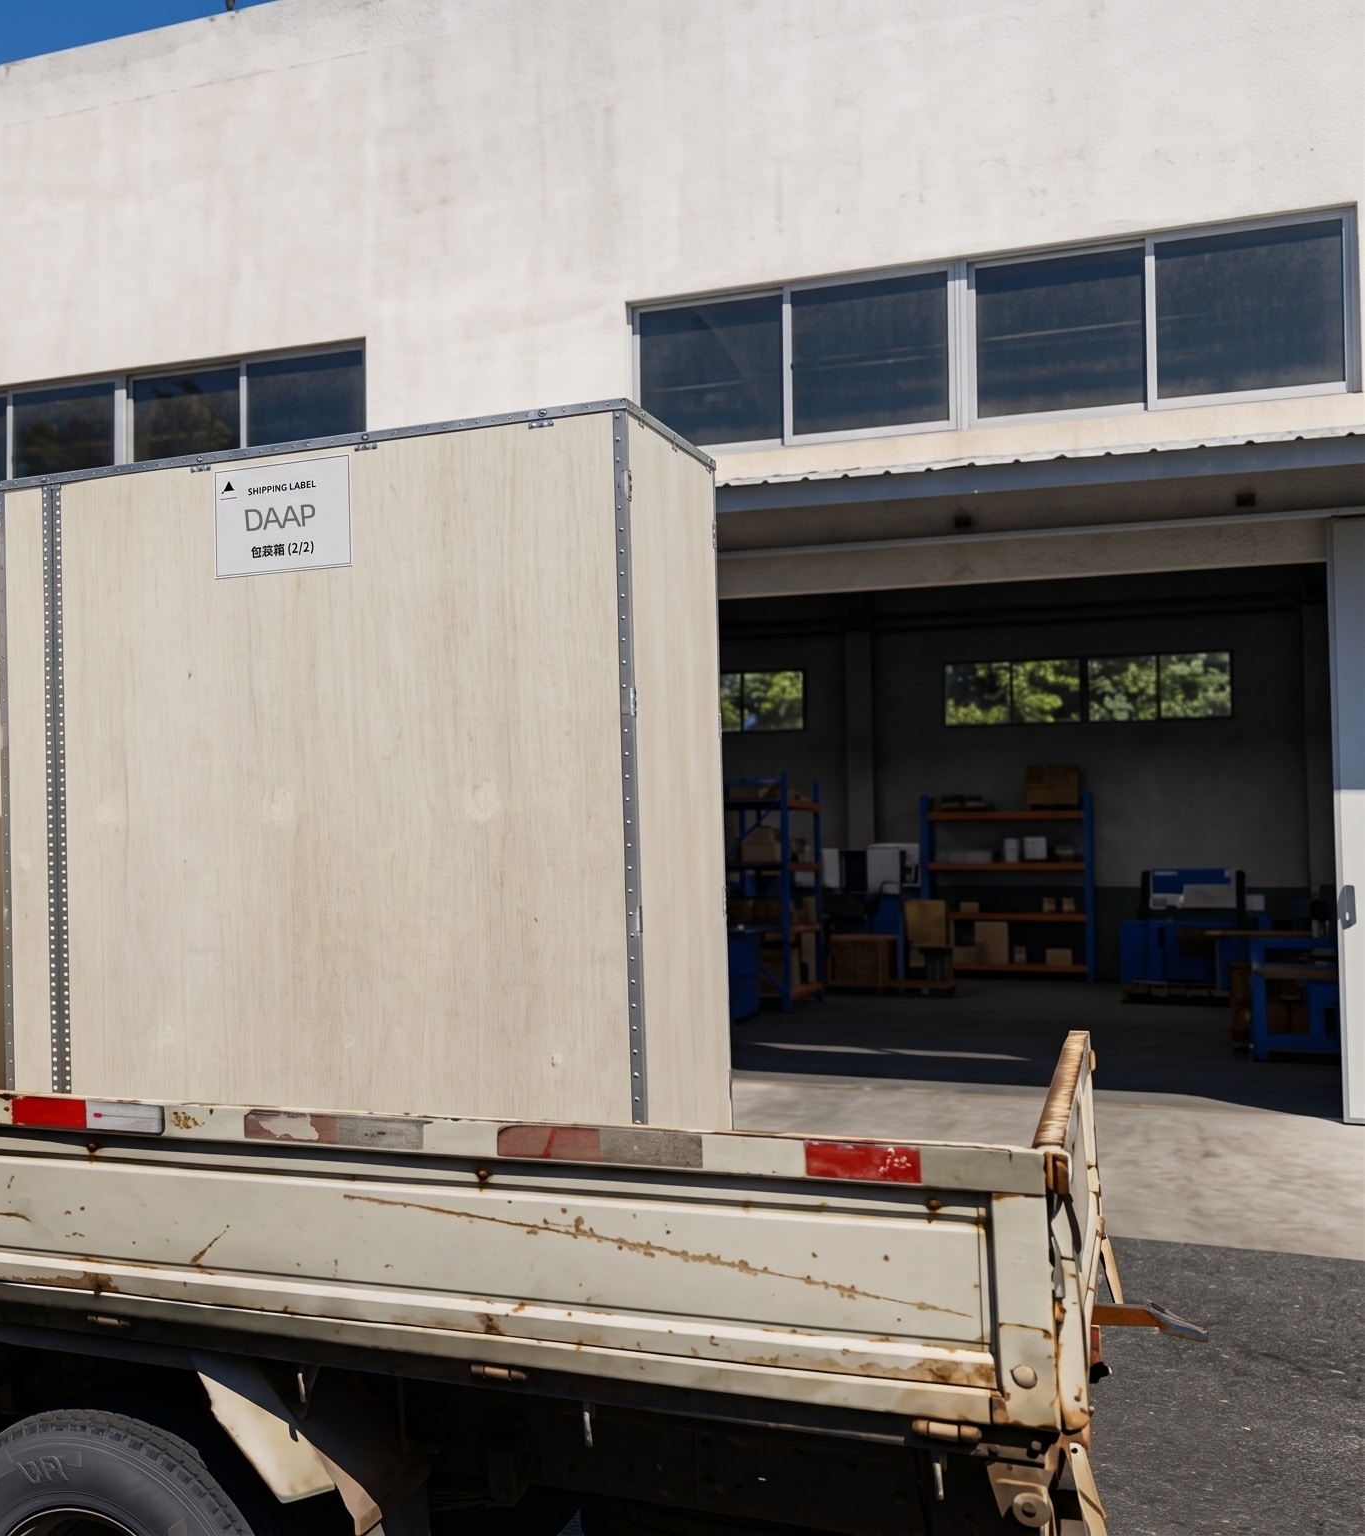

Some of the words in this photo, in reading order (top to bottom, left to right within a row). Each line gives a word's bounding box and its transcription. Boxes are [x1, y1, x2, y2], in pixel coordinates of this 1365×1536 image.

[247, 484, 288, 496] SHIPPING
[289, 480, 317, 491] LABEL
[244, 503, 316, 532] DAAP
[287, 540, 315, 556] (2/2)
